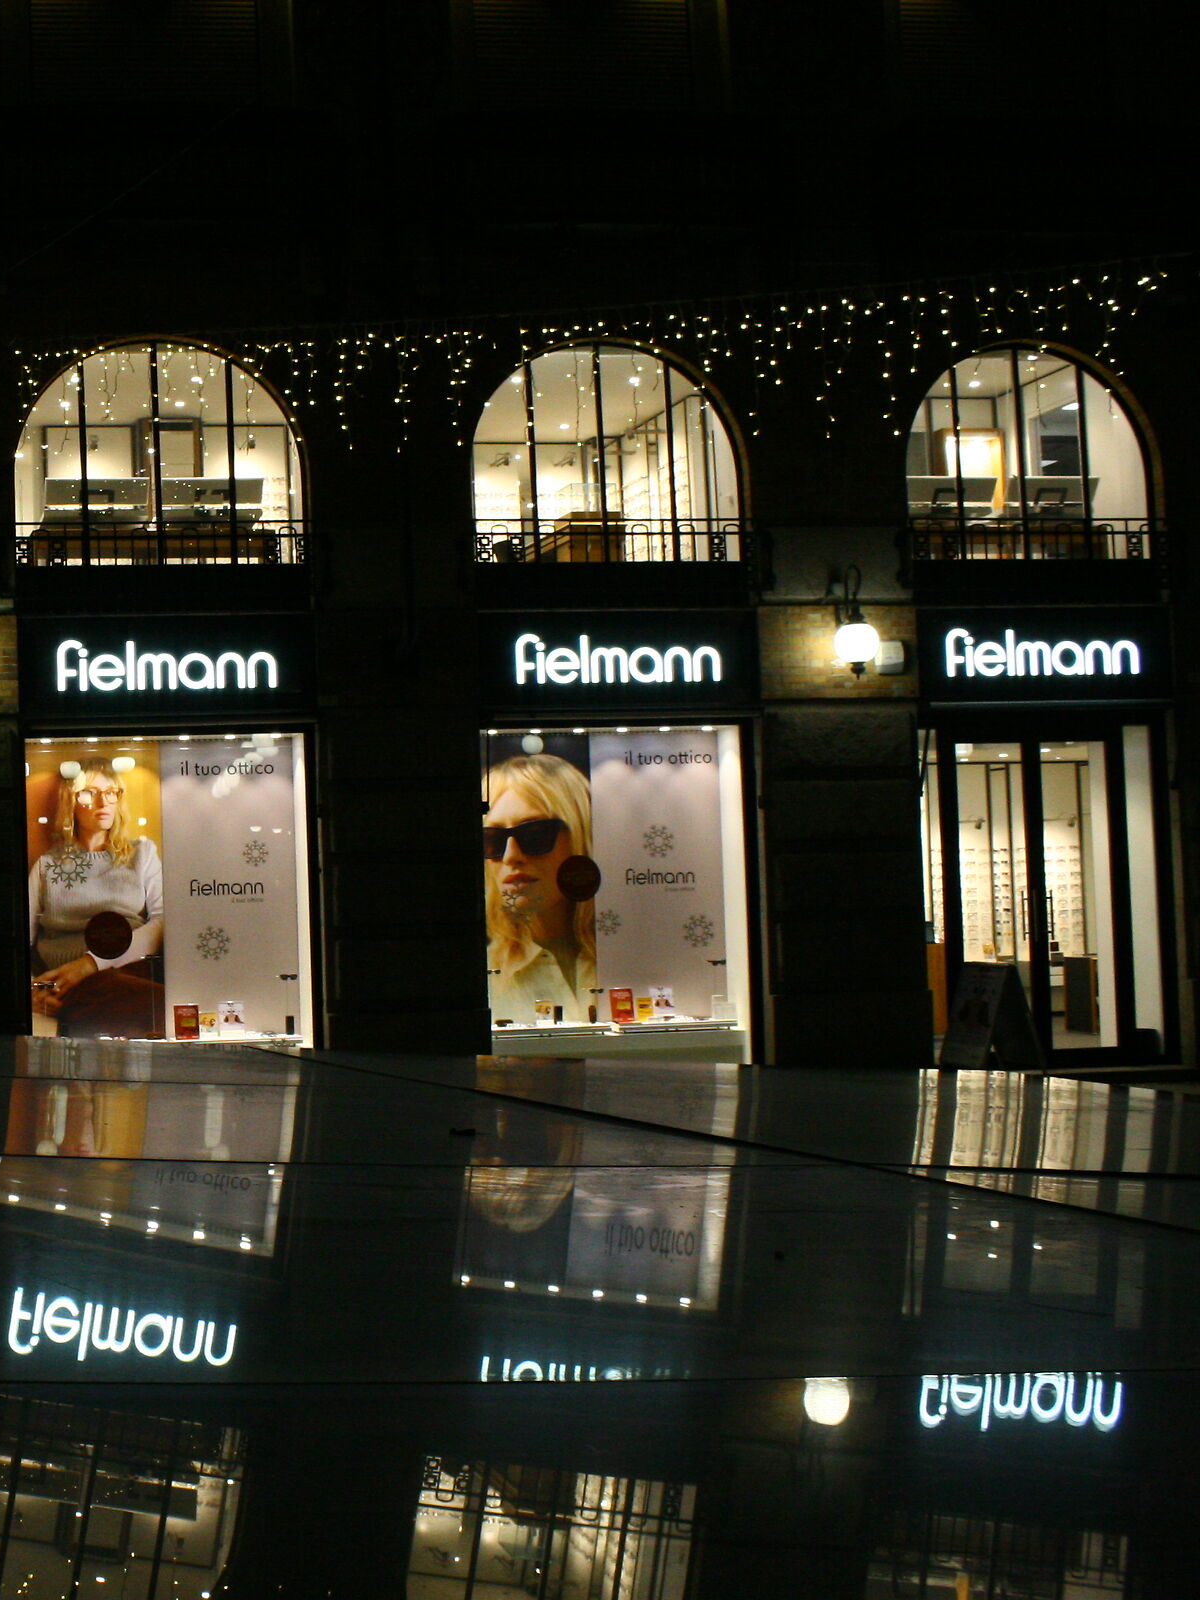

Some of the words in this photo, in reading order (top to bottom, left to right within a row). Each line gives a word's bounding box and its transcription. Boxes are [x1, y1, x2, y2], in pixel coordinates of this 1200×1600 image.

[624, 750, 633, 766] il
[638, 751, 663, 766] tuo
[668, 750, 712, 765] ottico
[180, 760, 189, 776] il
[194, 762, 221, 776] tuo
[227, 761, 274, 775] ottico
